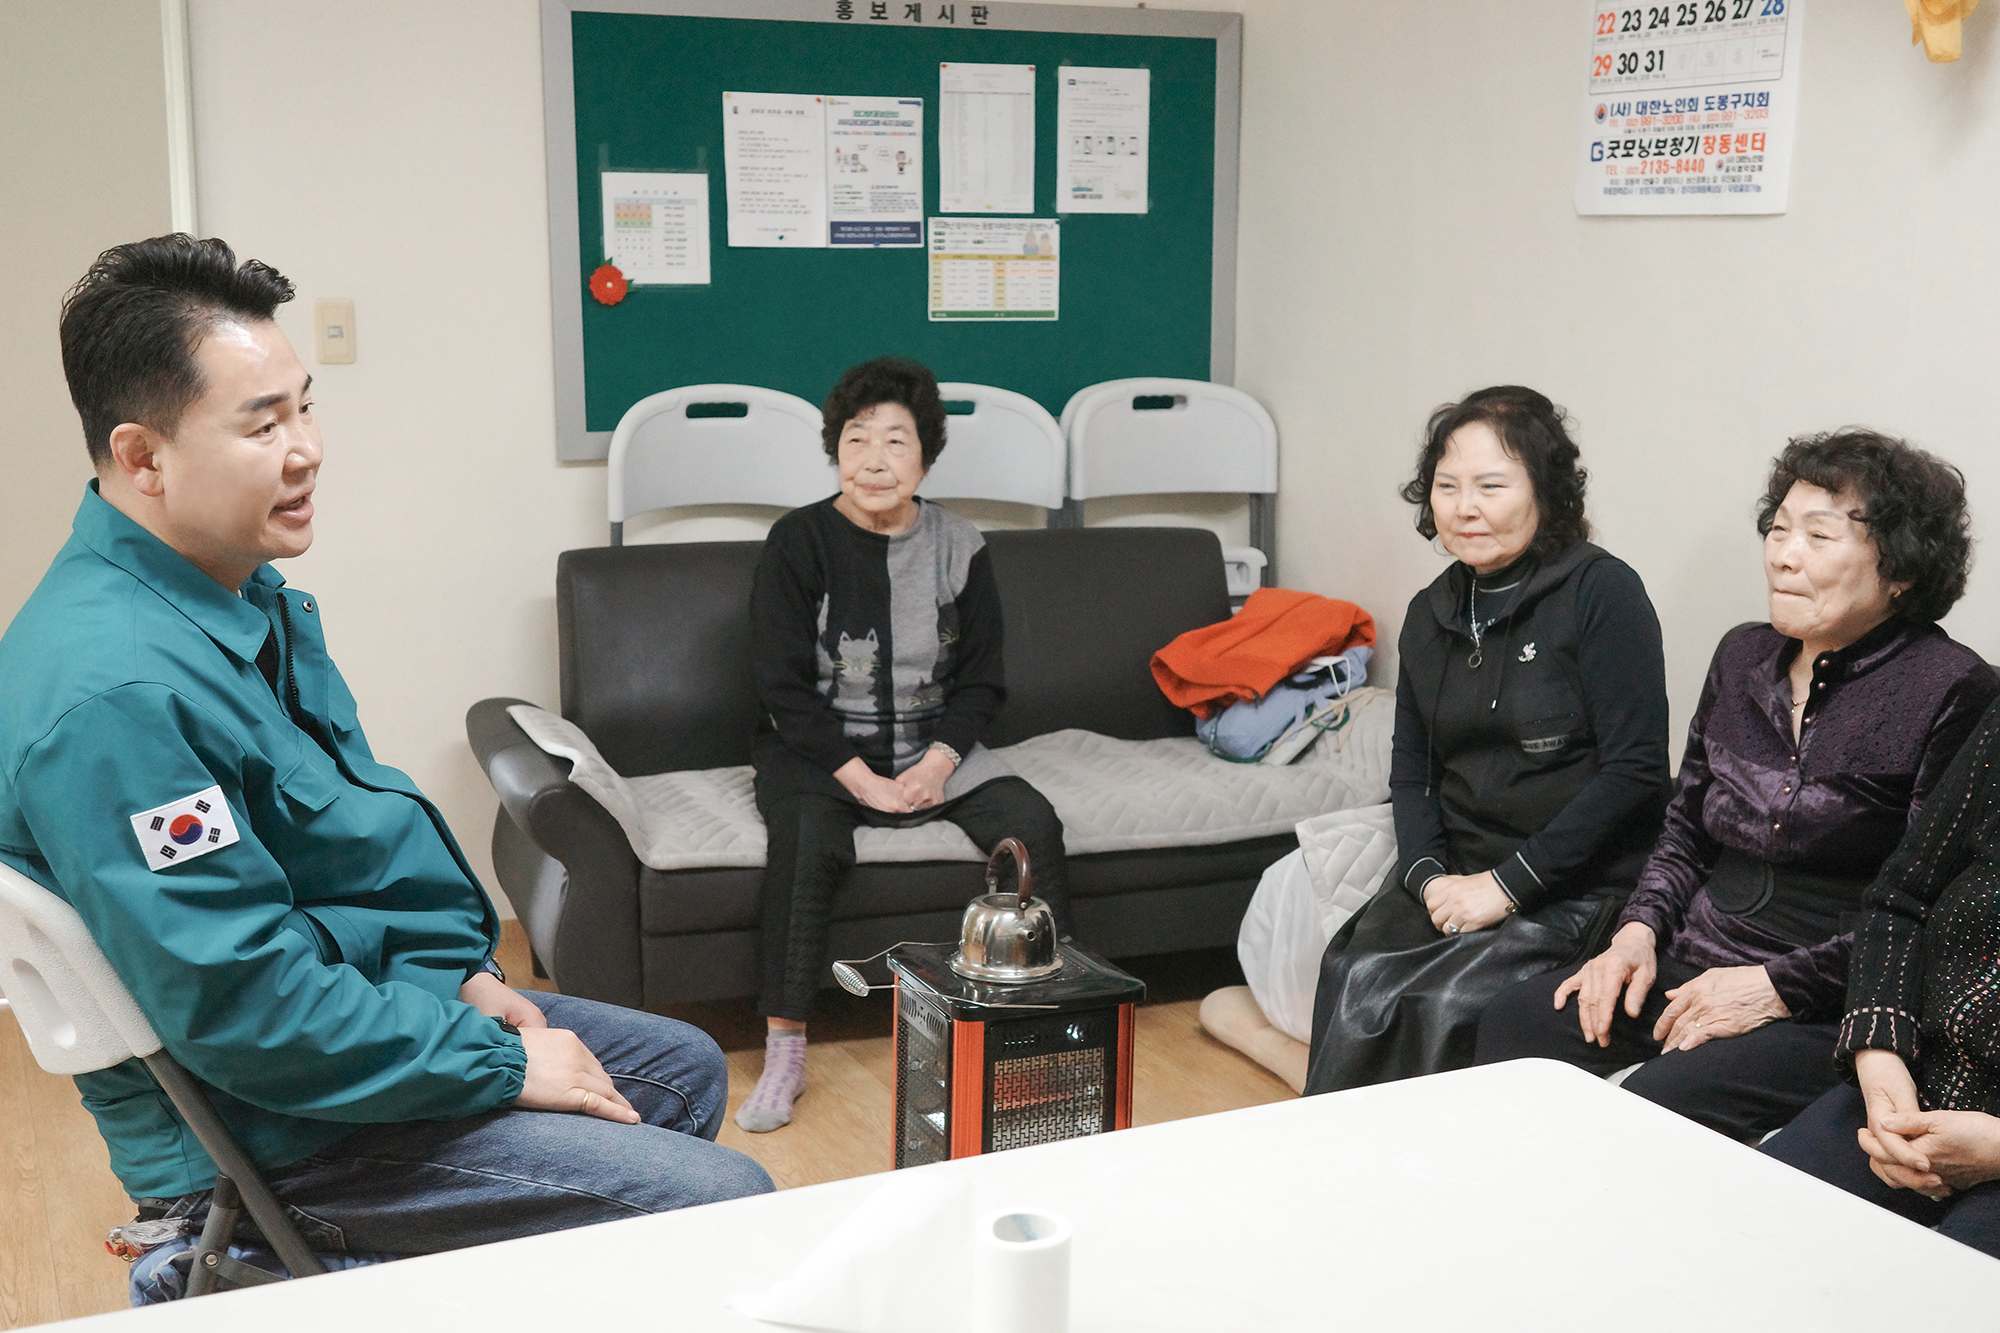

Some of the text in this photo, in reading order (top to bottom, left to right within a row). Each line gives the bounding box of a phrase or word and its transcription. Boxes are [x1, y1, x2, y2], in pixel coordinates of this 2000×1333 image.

[1597, 12, 1616, 35] 22
[1621, 9, 1642, 32] 23
[1648, 6, 1669, 29] 24
[1676, 3, 1697, 26] 25
[1704, 0, 1726, 23] 26
[1732, 0, 1753, 20] 27
[1760, 0, 1785, 16] 28
[1593, 50, 1664, 77] 29 30 31
[1610, 91, 1770, 117] (사) 대한노인회 도봉구지회
[1606, 136, 1700, 160] 굿모닝보청기
[1703, 132, 1766, 155] 창동센터
[1641, 158, 1705, 175] 2135-8440
